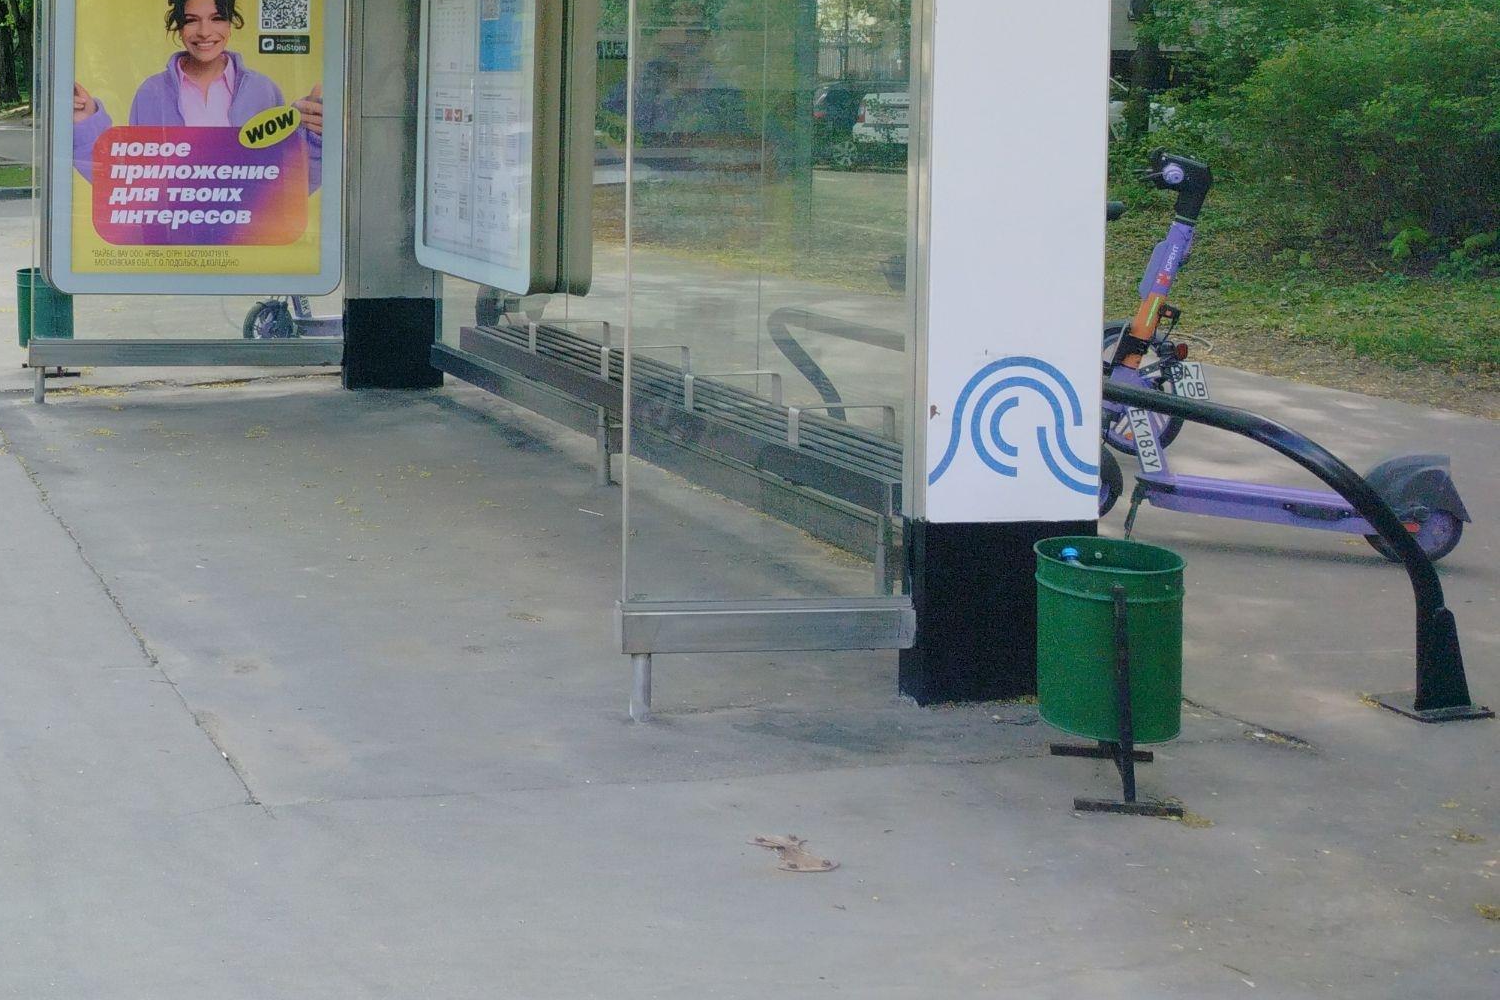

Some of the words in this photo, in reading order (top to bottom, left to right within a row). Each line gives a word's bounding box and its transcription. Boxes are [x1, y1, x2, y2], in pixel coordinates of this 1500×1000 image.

[110, 142, 191, 157] новое
[110, 164, 280, 184] приложение
[108, 187, 159, 205] для
[166, 187, 244, 202] твоих
[110, 209, 252, 229] интересов
